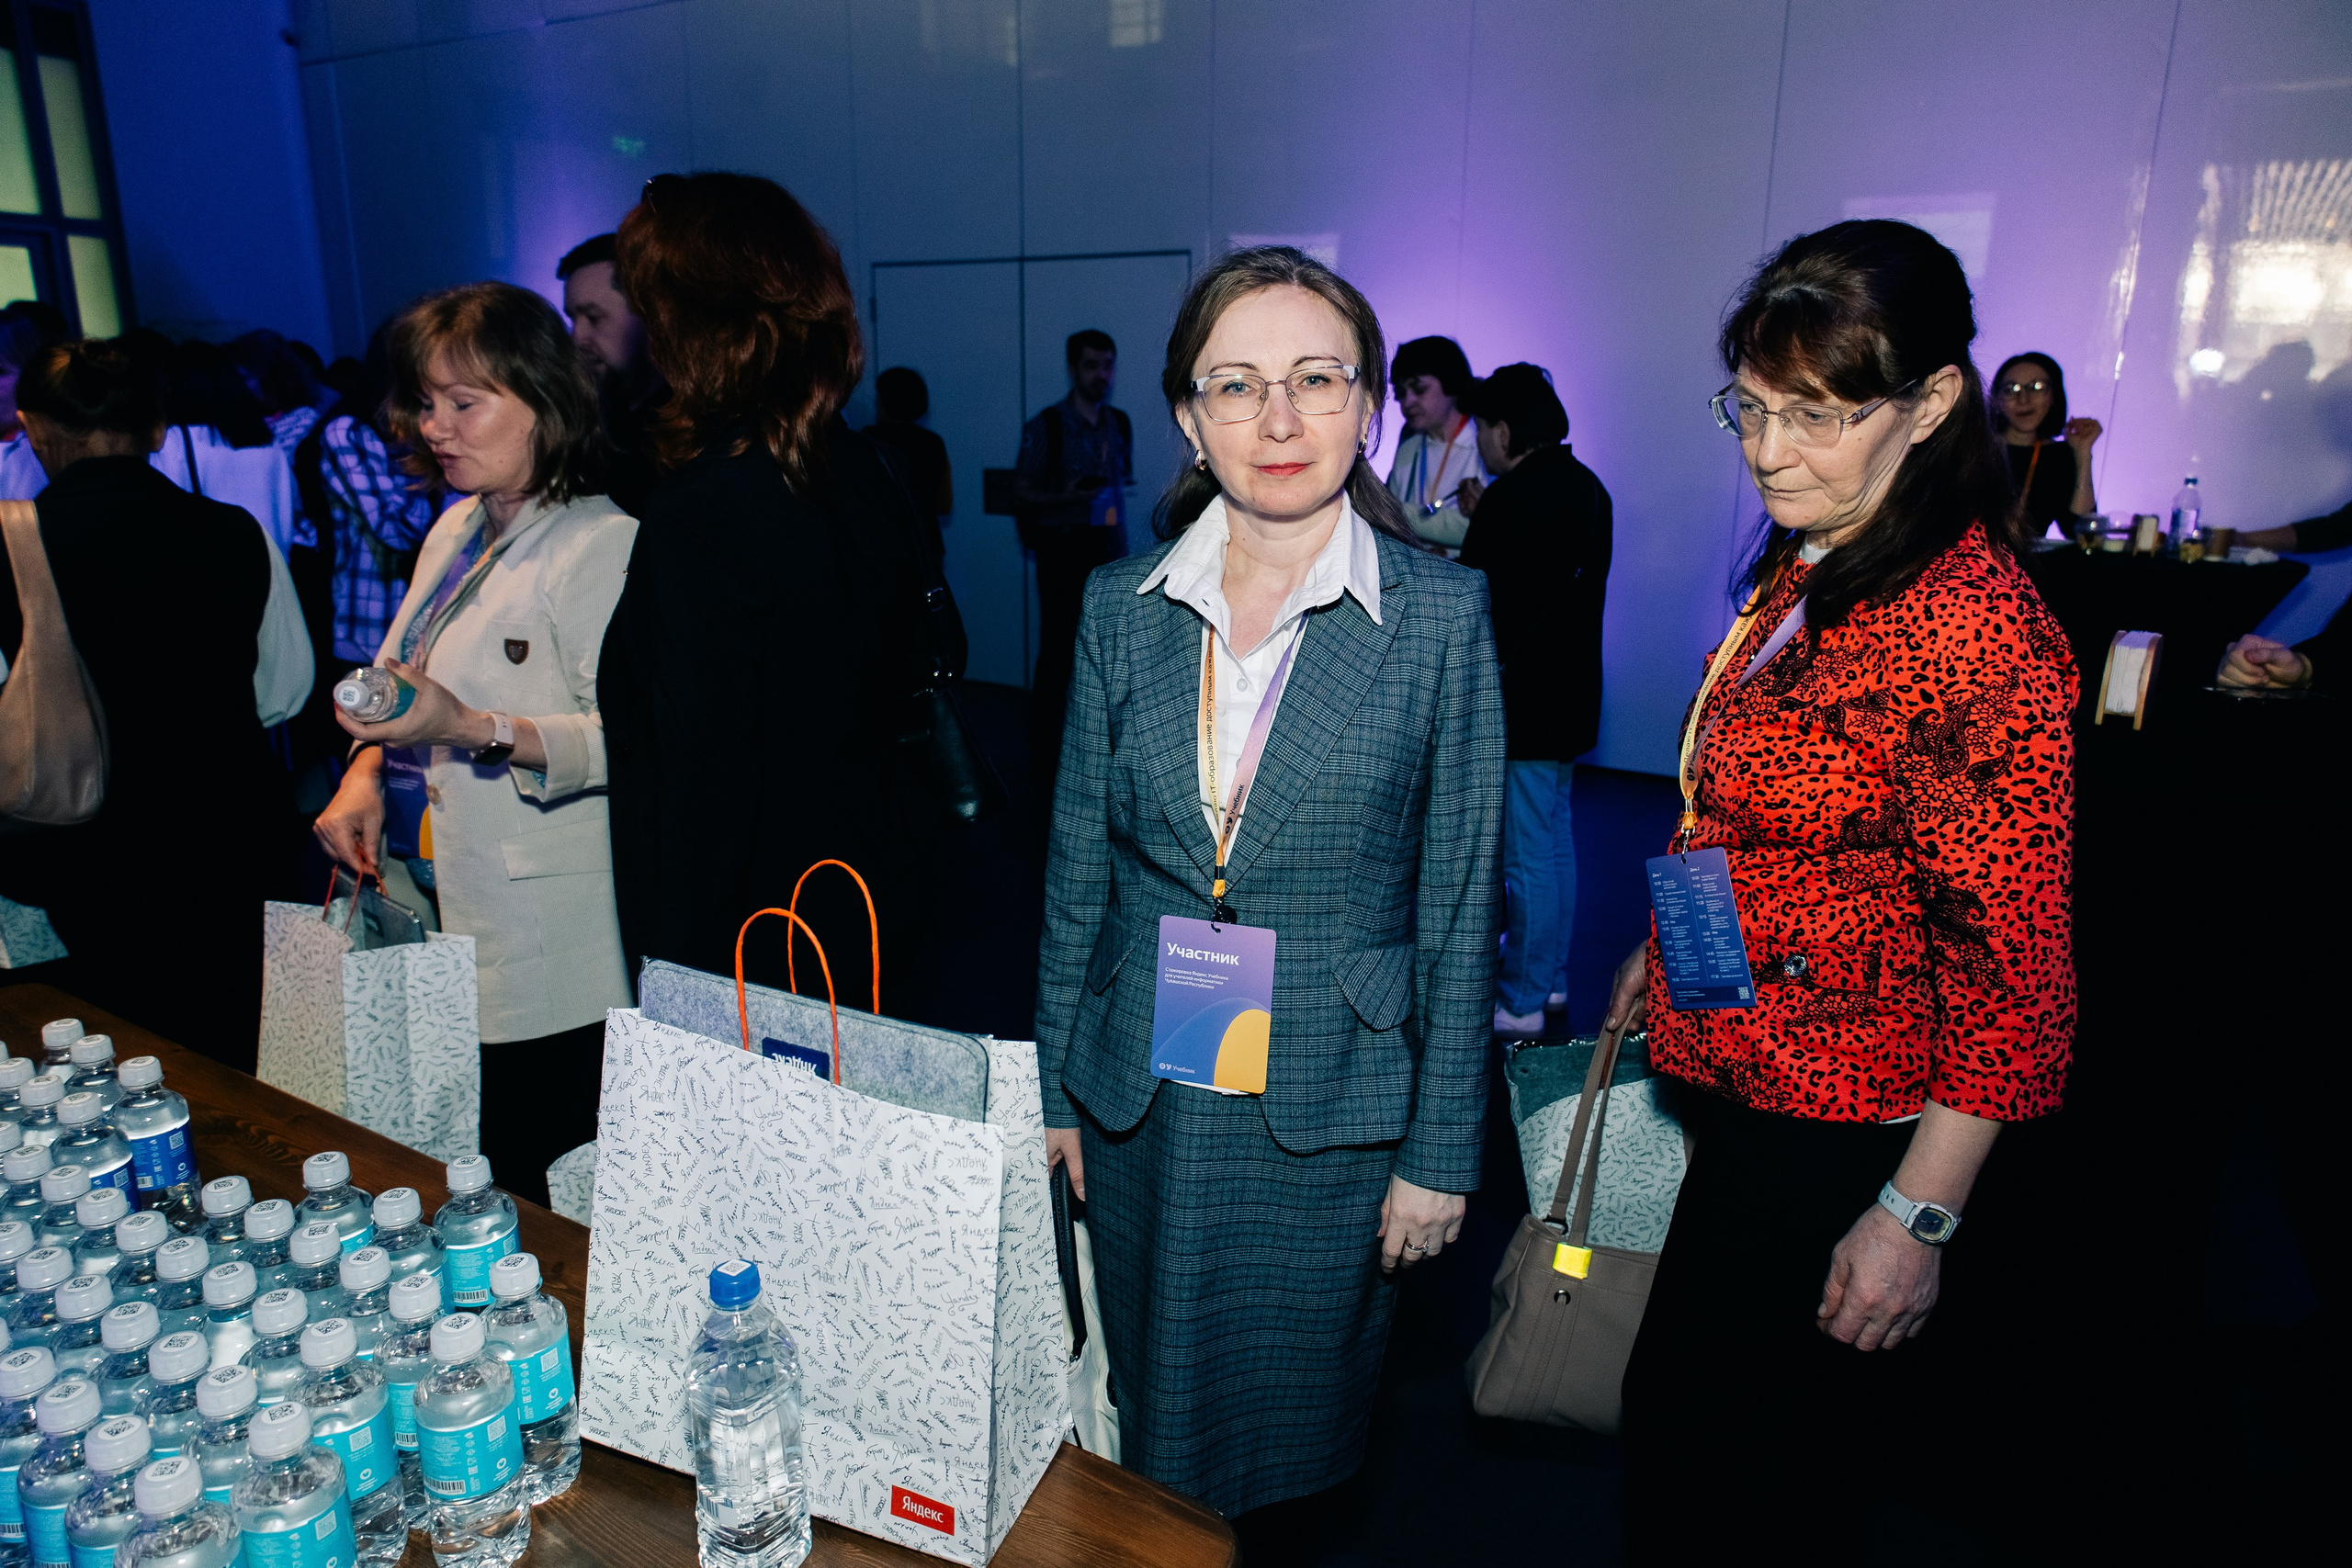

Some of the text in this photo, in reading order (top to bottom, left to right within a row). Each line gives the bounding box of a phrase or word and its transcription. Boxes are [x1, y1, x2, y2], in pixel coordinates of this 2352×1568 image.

[1714, 632, 1742, 672] доступным
[1206, 724, 1216, 794] IT-образование
[1229, 784, 1244, 816] Учебник
[1167, 942, 1240, 966] Участник
[1165, 966, 1192, 976] Стажировка
[1189, 981, 1215, 989] Республики
[1172, 1066, 1195, 1074] Учебник
[753, 1102, 785, 1132] Yandex
[962, 1224, 998, 1240] Яндек
[941, 1290, 979, 1315] Yandex
[663, 1402, 689, 1435] ANDEX
[955, 1456, 988, 1472] Яндек
[902, 1495, 944, 1523] Яндекс
